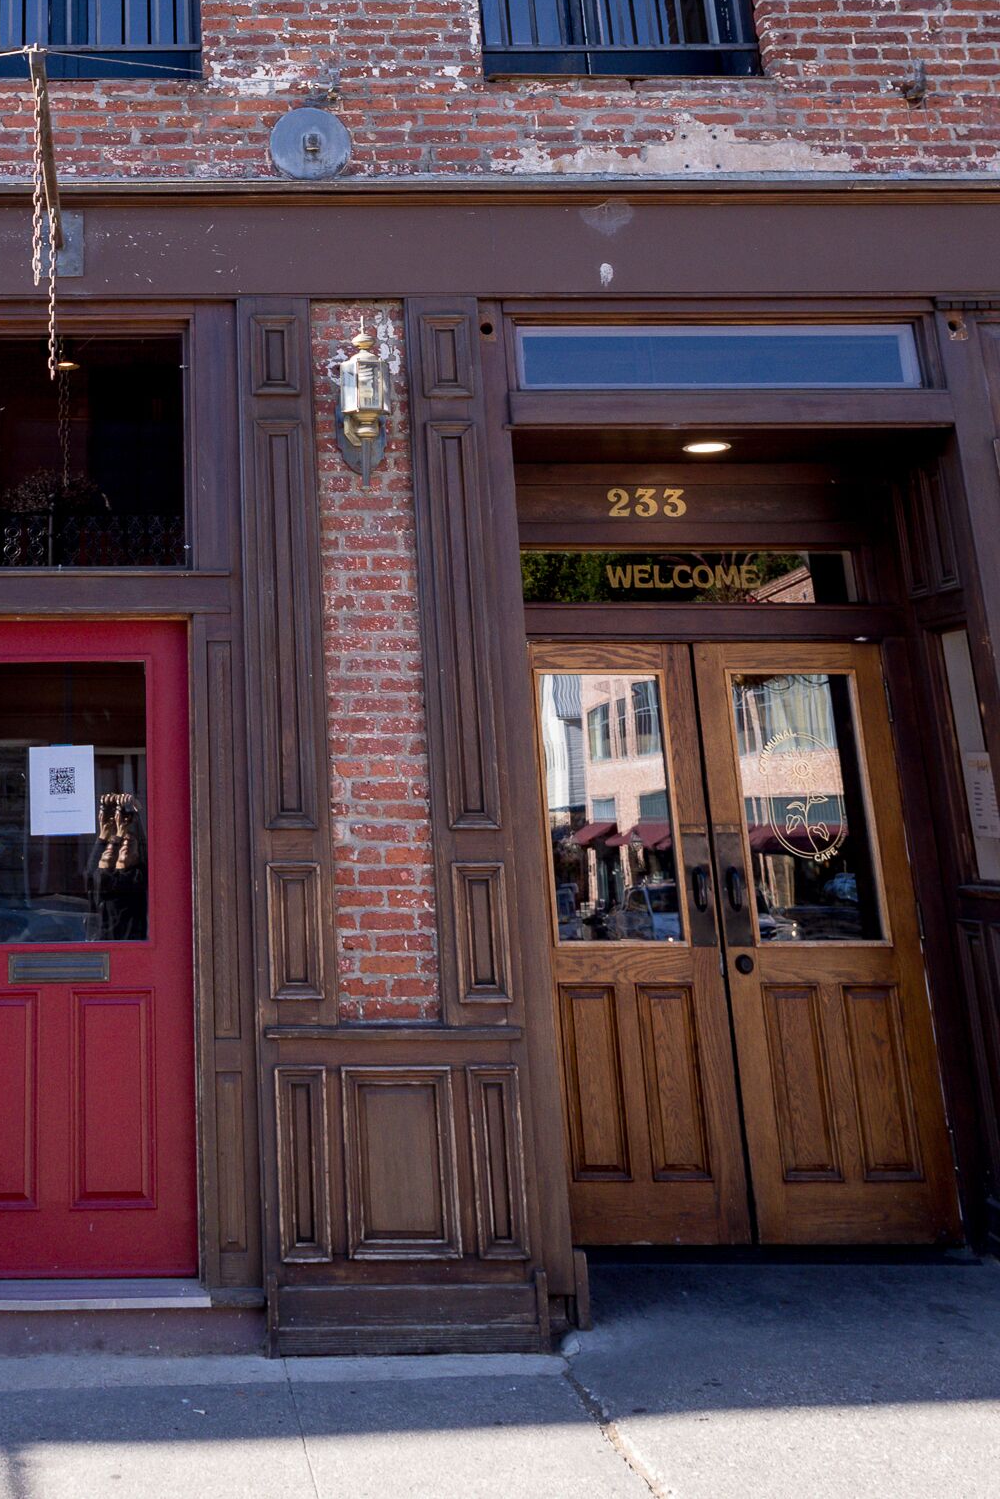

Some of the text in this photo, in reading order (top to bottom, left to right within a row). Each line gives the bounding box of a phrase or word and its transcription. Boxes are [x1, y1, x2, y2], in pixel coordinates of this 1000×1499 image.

[606, 487, 688, 518] 233
[605, 563, 762, 589] WELCOME
[759, 728, 797, 775] COMMUNAL
